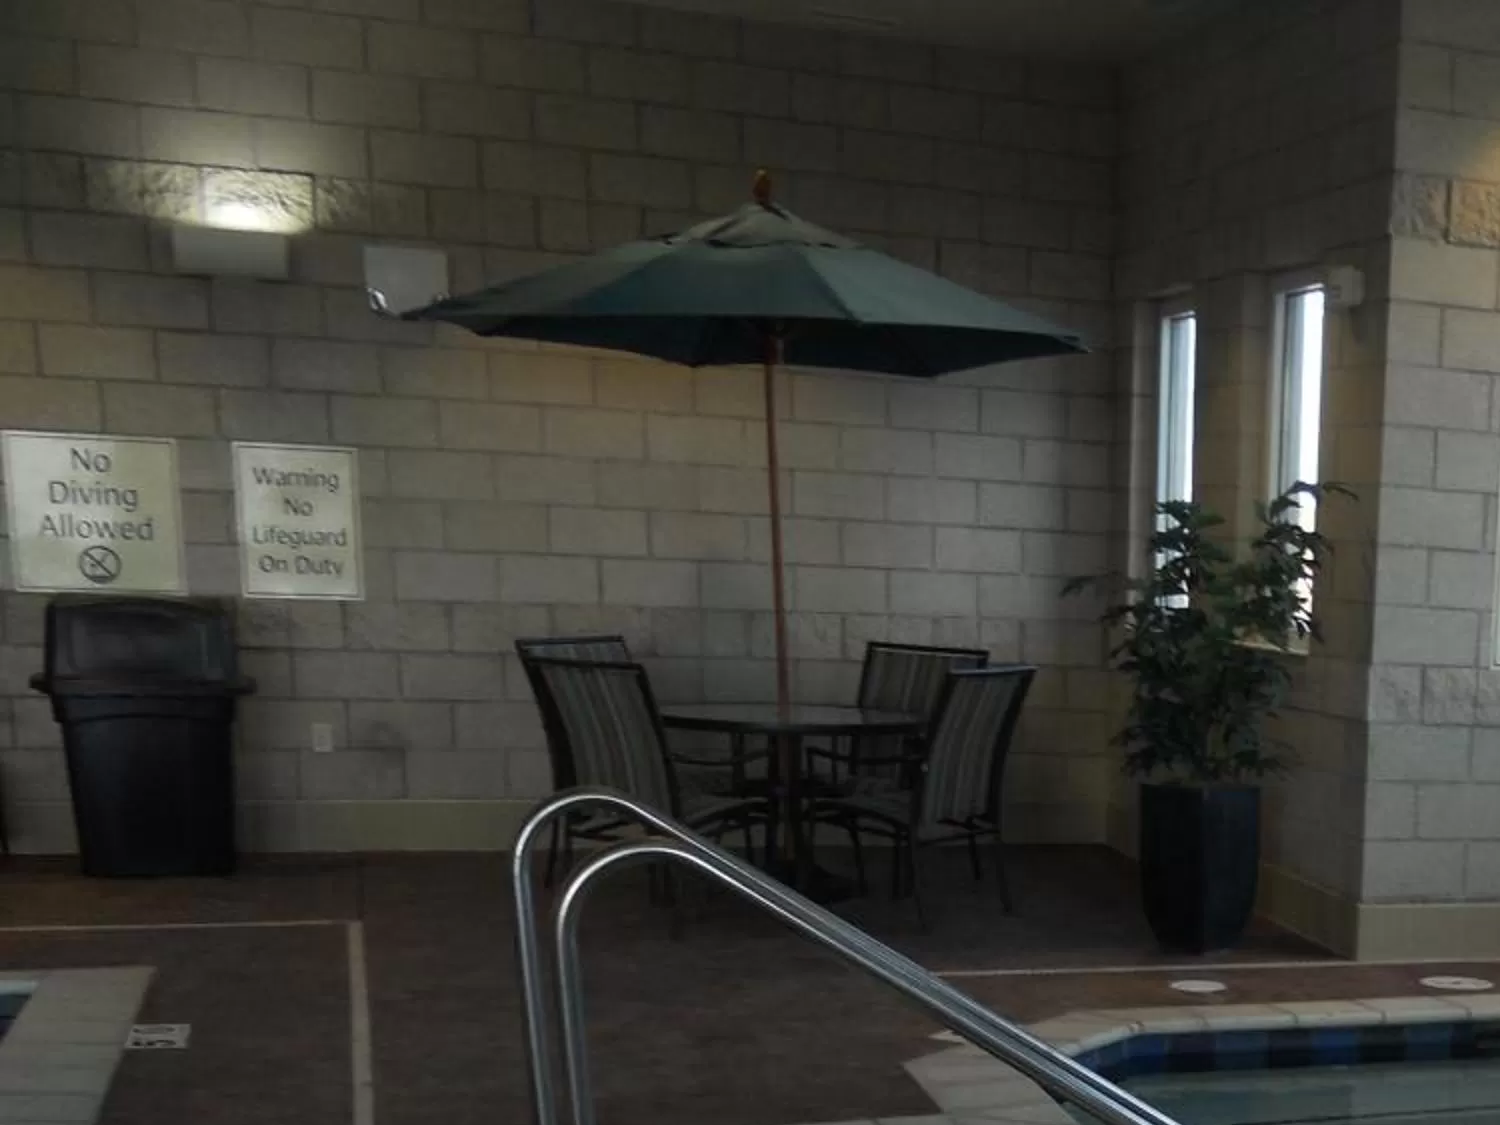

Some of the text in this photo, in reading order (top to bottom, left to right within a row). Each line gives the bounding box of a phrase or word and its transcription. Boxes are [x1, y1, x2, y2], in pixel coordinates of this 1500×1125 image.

[70, 447, 112, 474] No
[251, 466, 340, 493] Warning
[48, 480, 138, 512] Diving
[283, 497, 313, 518] No
[39, 513, 154, 542] Allowed
[252, 526, 348, 549] Lifeguard
[258, 554, 344, 577] On Duty
